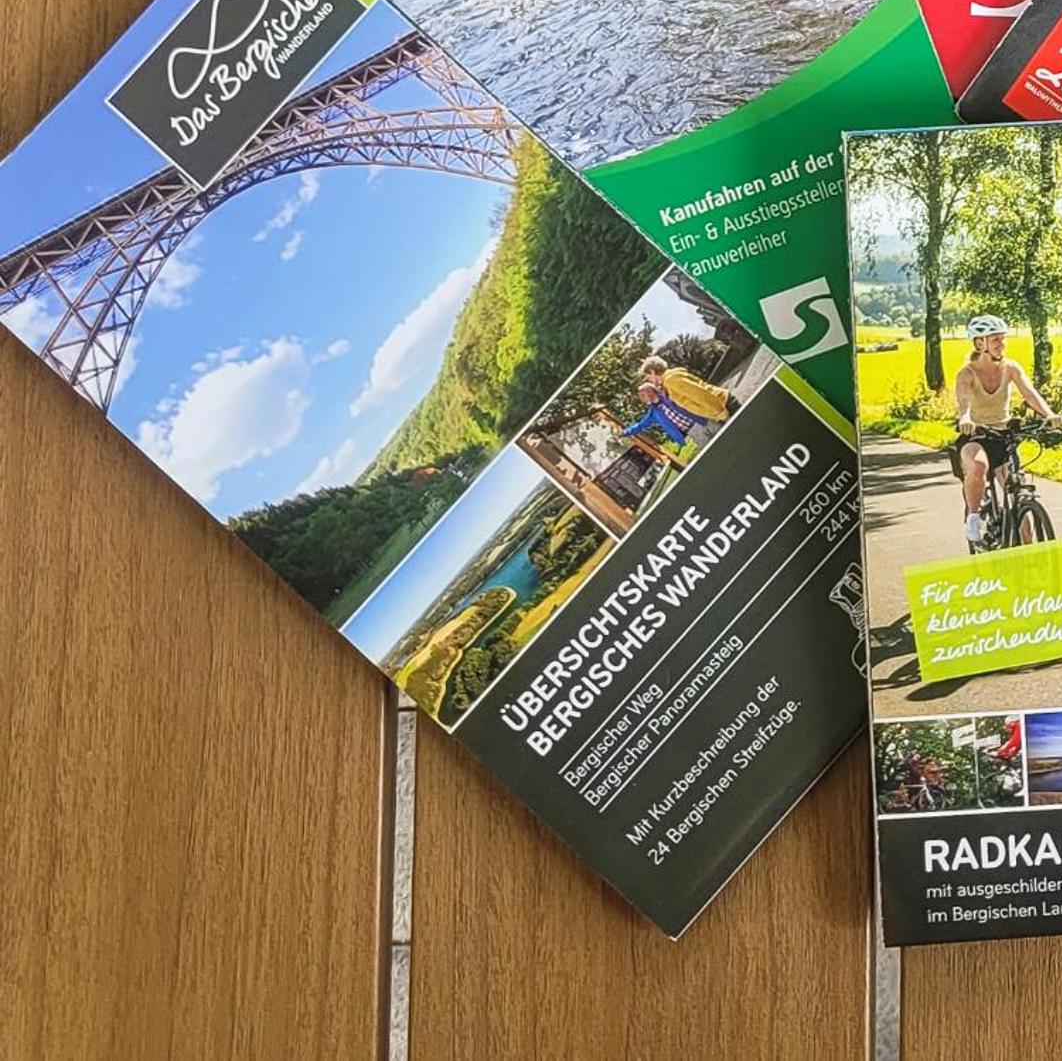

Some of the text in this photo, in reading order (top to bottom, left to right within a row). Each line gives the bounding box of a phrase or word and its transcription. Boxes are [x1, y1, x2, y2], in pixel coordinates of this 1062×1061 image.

[275, 3, 333, 64] WANDERLAND
[170, 94, 221, 146] Das
[659, 152, 834, 226] Kanufahren auf der
[669, 232, 700, 254] Ein-
[705, 222, 718, 241] &
[501, 505, 710, 731] ÜBERSICHTSKARTE
[526, 442, 811, 757] BERGISCHES WANDERLAND
[920, 577, 1008, 605] Für den
[926, 608, 1007, 633] kleinen
[563, 470, 853, 787] Bergischer Weg 260 km
[583, 733, 653, 806] Bergischer
[647, 635, 744, 735] Panoramasteig
[820, 509, 852, 542] 244
[625, 676, 781, 846] Mit Kurzbeschreibung der
[647, 701, 802, 865] 24 Bergischen Streifzüge.
[926, 881, 953, 899] mit
[927, 907, 948, 923] im
[952, 903, 1037, 923] Bergischen
